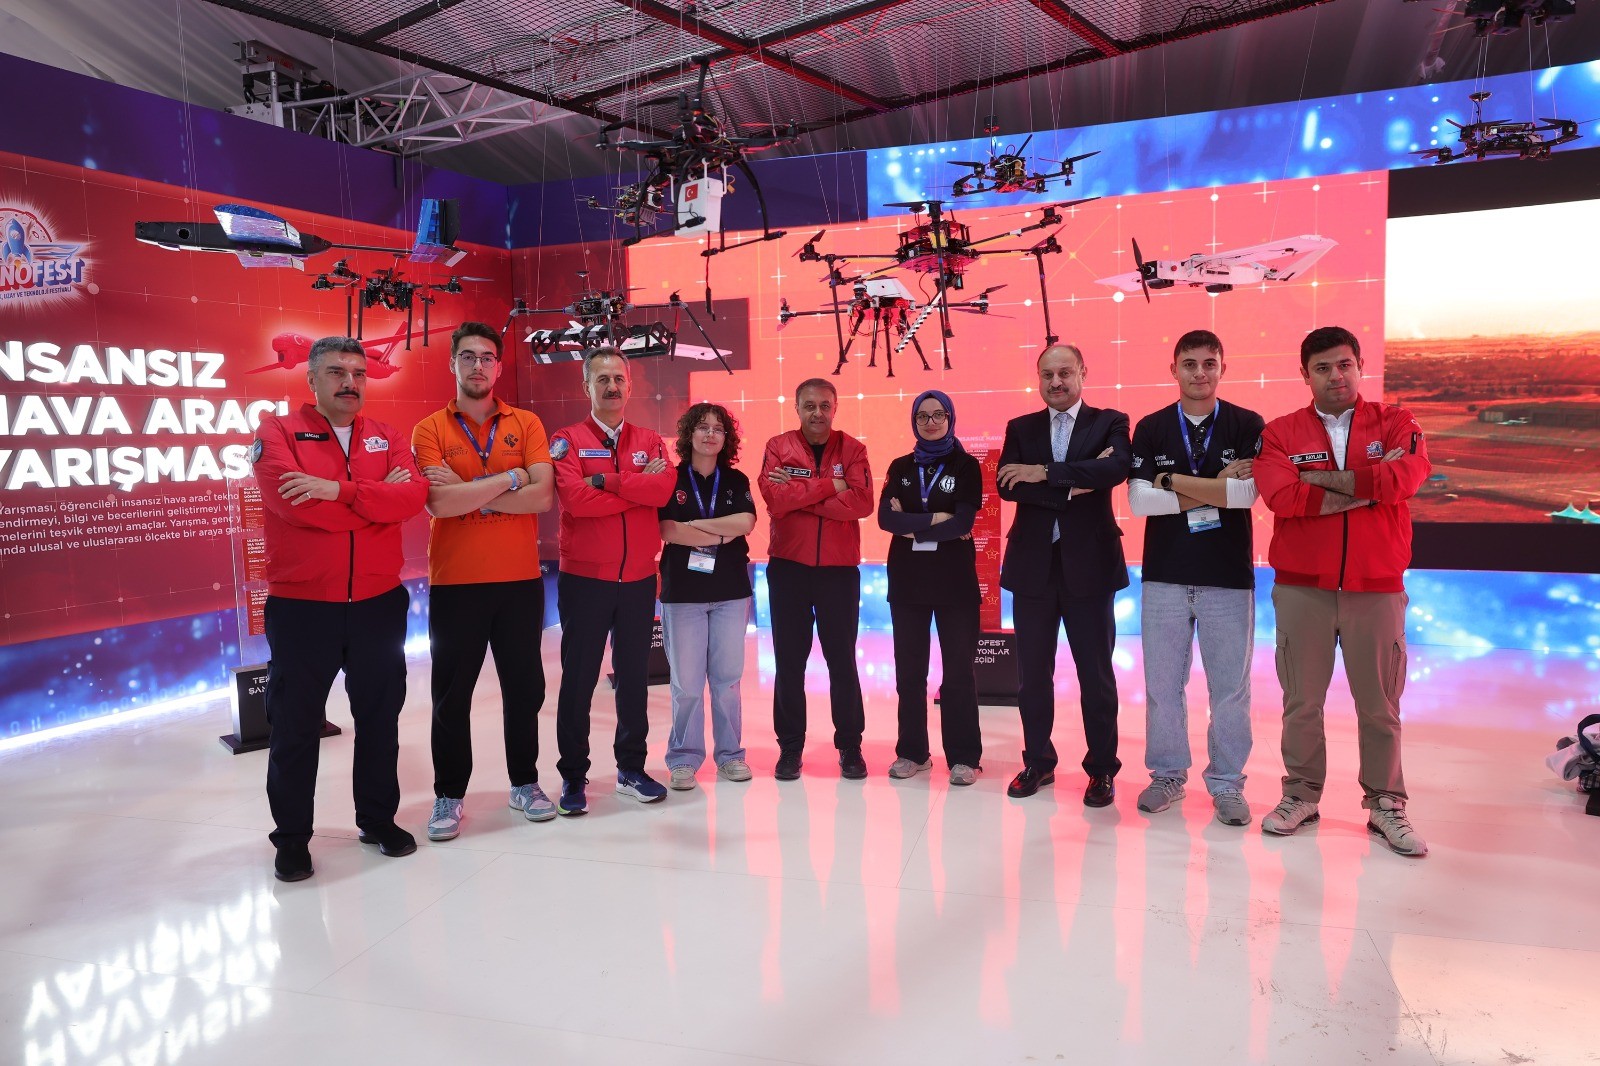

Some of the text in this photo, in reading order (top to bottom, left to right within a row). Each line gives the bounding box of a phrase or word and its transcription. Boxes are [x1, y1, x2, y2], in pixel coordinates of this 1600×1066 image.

[1305, 453, 1323, 461] BAYLAN
[60, 499, 118, 513] öğrencileri
[121, 498, 161, 507] insansız
[164, 495, 187, 505] hava
[189, 494, 211, 503] aracı
[64, 513, 88, 524] bilgi
[92, 513, 104, 521] ve
[107, 508, 164, 520] becerilerini
[167, 503, 221, 517] geliştirmeyi
[50, 526, 83, 538] teşvik
[86, 522, 122, 534] etmeyi
[126, 520, 167, 531] amaçlar.
[169, 516, 209, 527] Yarışma,
[30, 541, 63, 553] ulusal
[66, 541, 79, 549] ve
[83, 535, 142, 548] uluslararası
[145, 530, 181, 542] ölçekte
[183, 529, 196, 538] bir
[198, 527, 222, 538] araya
